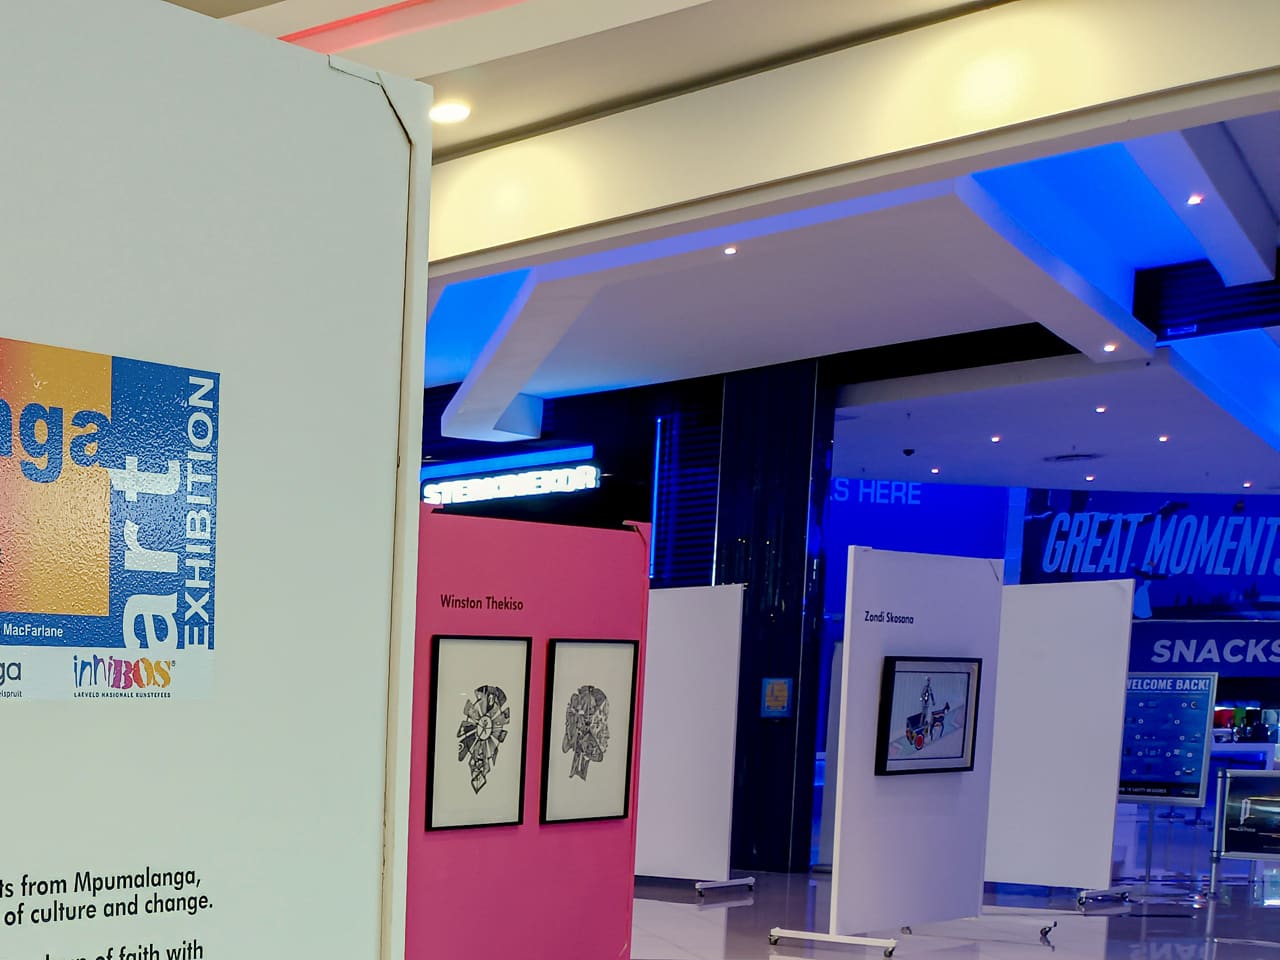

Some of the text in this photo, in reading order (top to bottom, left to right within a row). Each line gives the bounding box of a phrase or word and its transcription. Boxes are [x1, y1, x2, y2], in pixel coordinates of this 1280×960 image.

[859, 479, 922, 505] HERE
[184, 375, 215, 650] EXHIBITION
[111, 455, 181, 649] art
[1042, 511, 1280, 577] GREAT MOMENT
[440, 594, 524, 610] Winston Thekiso
[3, 622, 63, 638] MacFarlane
[1176, 680, 1209, 690] BACK!
[20, 873, 67, 897] from
[73, 866, 201, 898] Mpumalanga,
[4, 902, 25, 926] of
[30, 899, 97, 924] culture
[103, 893, 138, 918] and
[144, 892, 213, 916] change.
